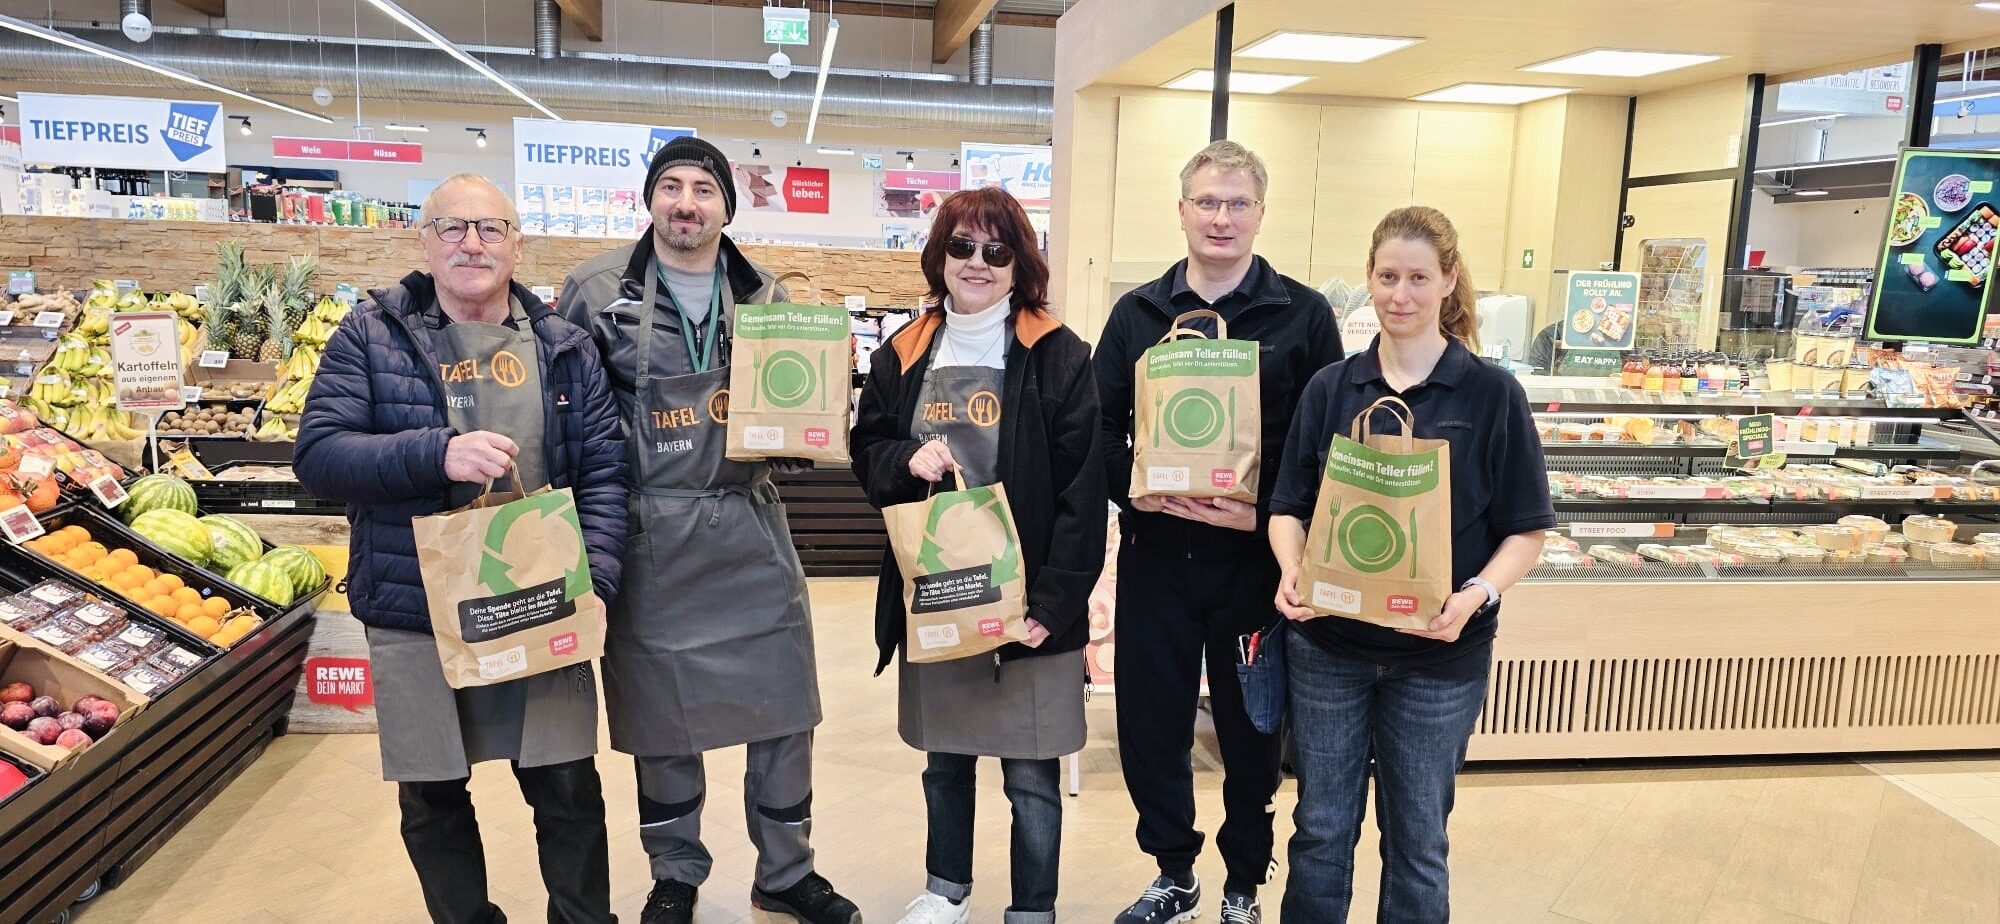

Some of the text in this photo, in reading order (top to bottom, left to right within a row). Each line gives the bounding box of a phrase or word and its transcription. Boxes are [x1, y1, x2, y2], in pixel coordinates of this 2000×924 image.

[172, 111, 209, 132] TIEF
[30, 119, 150, 144] TIEFPREIS
[172, 130, 200, 145] PREIS
[301, 145, 321, 155] Wein
[373, 148, 397, 158] Nüsse
[524, 143, 631, 168] TIEFPREIS
[791, 179, 824, 187] Glücklicher
[906, 177, 929, 186] Tücher
[792, 188, 825, 199] leben.
[1576, 278, 1632, 289] DER FRÜHLING
[1583, 288, 1623, 297] ROLLT AN.
[741, 312, 843, 325] Gemeinsam Teller füllen!
[1150, 348, 1251, 364] Gemeinsam Teller füllen!
[1574, 355, 1617, 366] EAT HAPPY
[118, 361, 178, 372] Kartoffeln
[440, 358, 483, 382] TAFEL
[139, 375, 177, 383] eigenem
[136, 385, 164, 393] Anbau
[922, 402, 957, 421] TAFEL
[651, 407, 700, 429] TAFEL
[656, 438, 693, 453] BAYERN
[1376, 461, 1405, 477] Teller
[943, 579, 956, 587] geht
[965, 582, 984, 590] Markt.
[469, 587, 562, 616] Deine Spende geht an die Tafel.
[477, 614, 494, 623] Diese
[495, 610, 510, 620] Tüte
[510, 606, 527, 616] bleibt
[528, 602, 536, 610] im
[537, 597, 558, 608] Markt.
[981, 621, 1000, 629] REWE
[553, 635, 573, 647] REWE
[316, 666, 365, 681] REWE
[316, 681, 366, 695] DEIN MARKT
